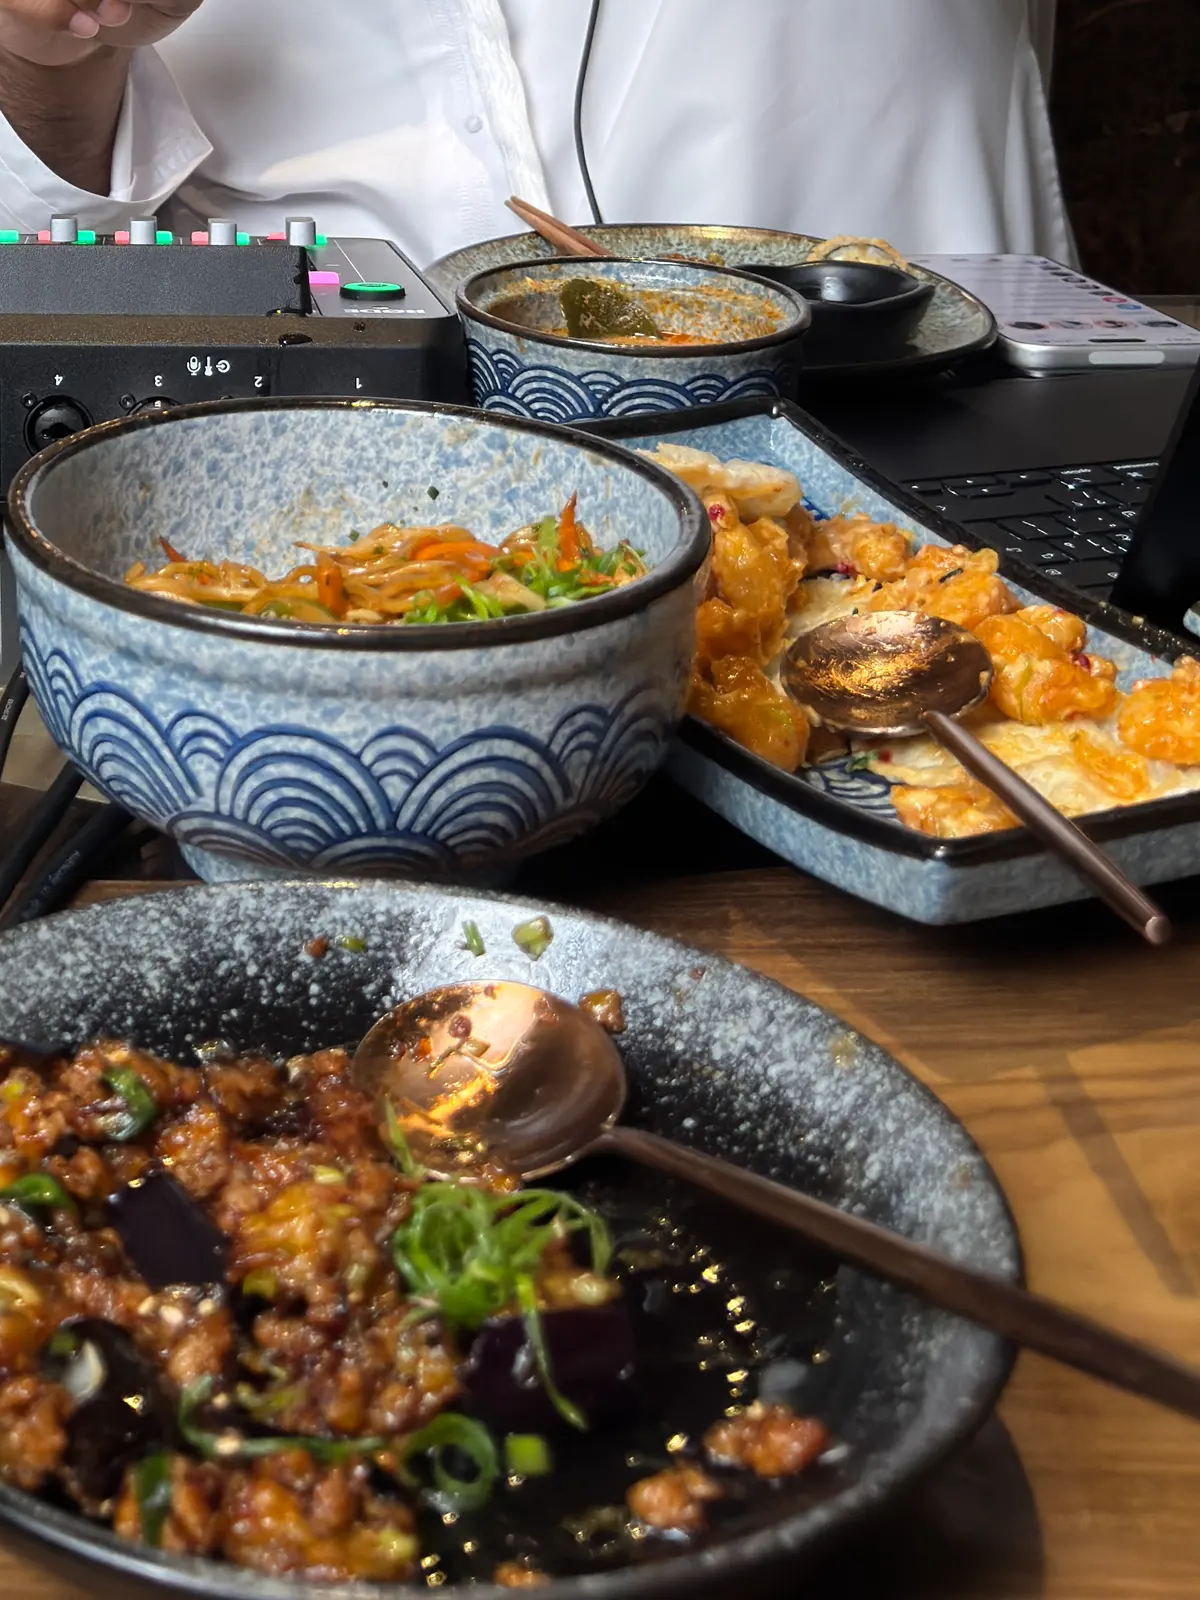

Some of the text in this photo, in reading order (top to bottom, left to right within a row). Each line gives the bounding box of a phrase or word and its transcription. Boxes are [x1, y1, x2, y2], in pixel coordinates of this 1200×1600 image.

[54, 374, 64, 386] 4
[154, 375, 163, 387] 3
[253, 375, 263, 388] 2
[355, 377, 363, 389] 1
